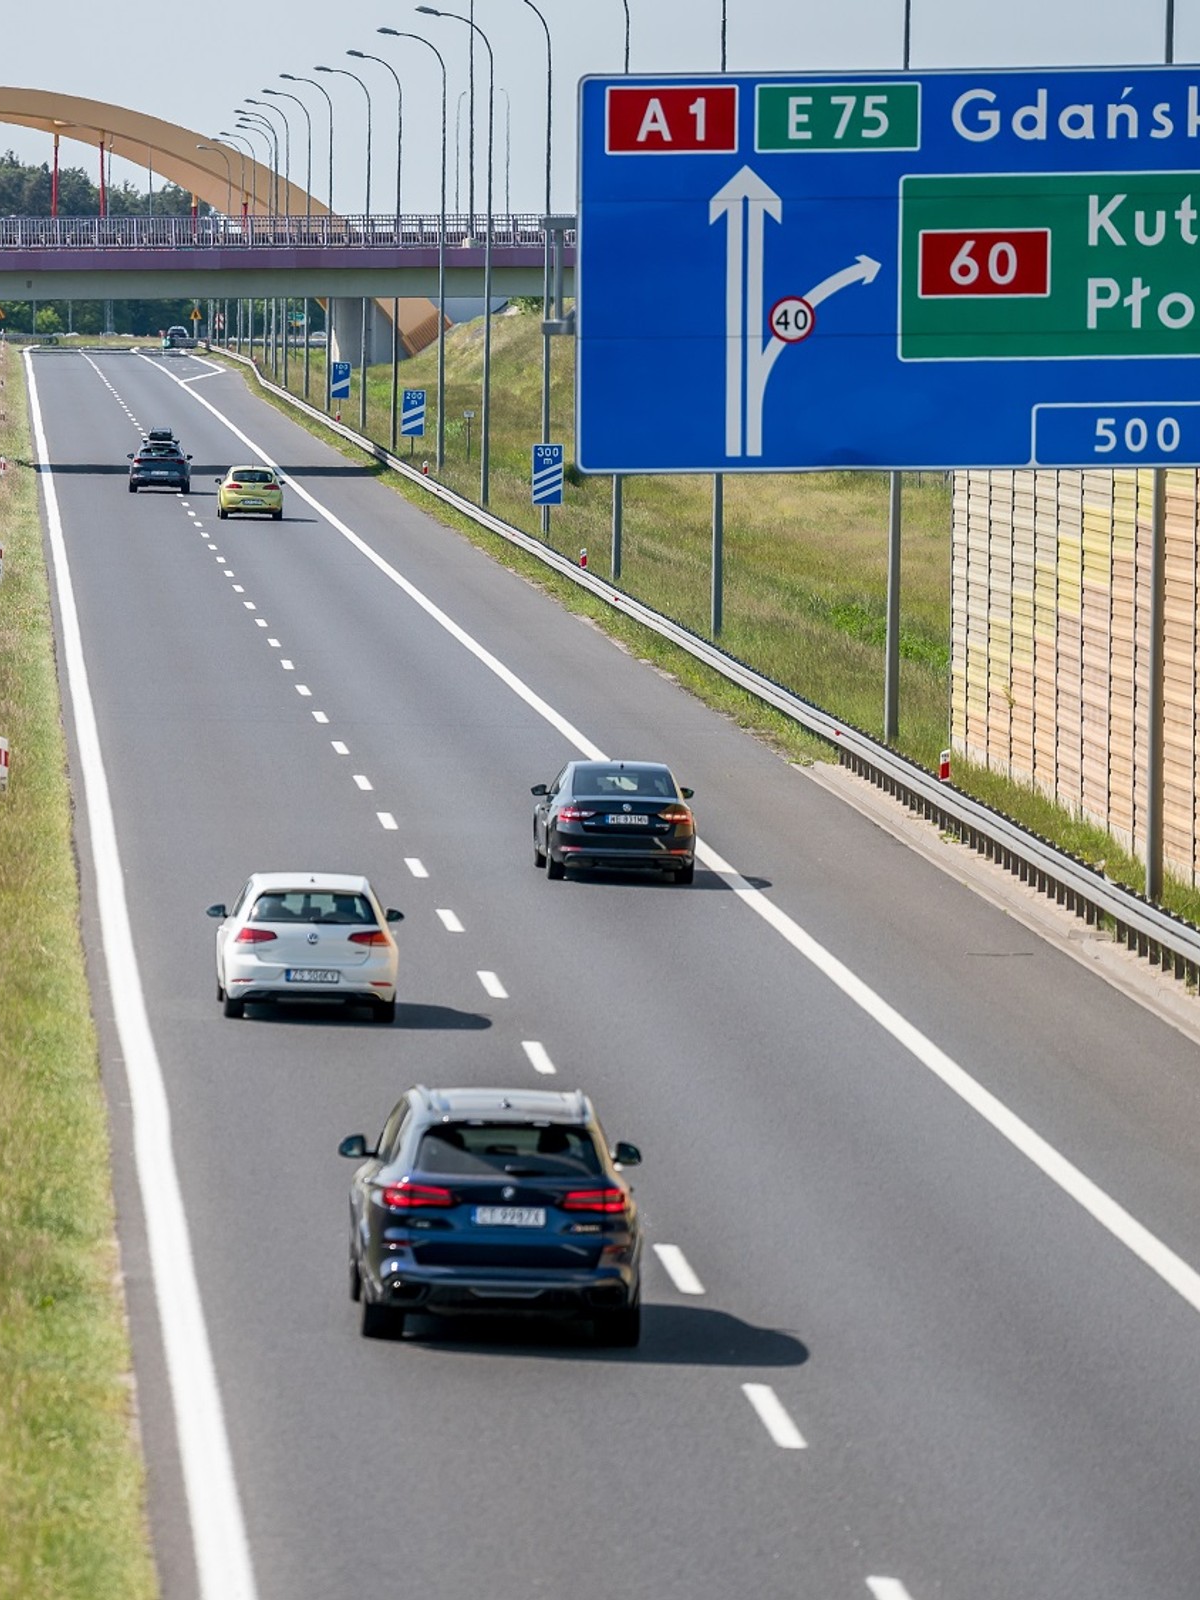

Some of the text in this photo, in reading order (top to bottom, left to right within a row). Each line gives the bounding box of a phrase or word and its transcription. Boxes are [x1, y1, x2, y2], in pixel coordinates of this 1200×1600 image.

[636, 97, 707, 142] A 1
[788, 95, 890, 140] E 75
[949, 240, 1018, 285] 60
[775, 308, 808, 331] 40
[406, 392, 423, 400] 200
[537, 447, 559, 457] 300
[1094, 417, 1180, 453] 500
